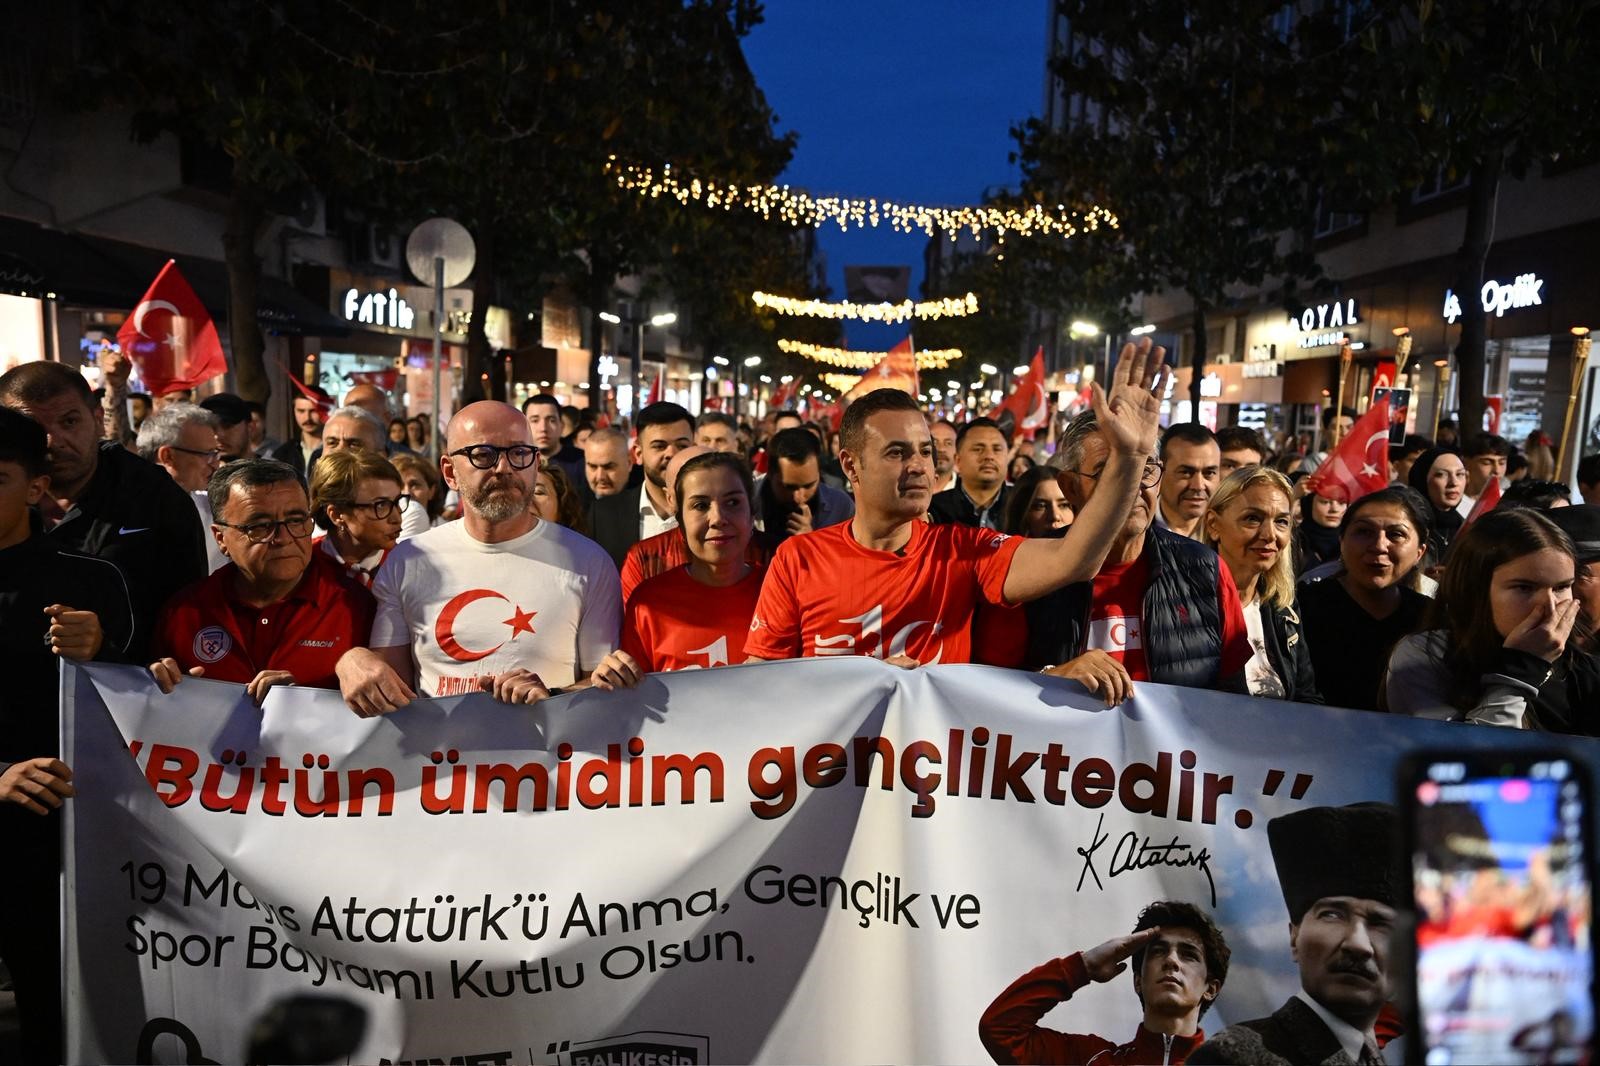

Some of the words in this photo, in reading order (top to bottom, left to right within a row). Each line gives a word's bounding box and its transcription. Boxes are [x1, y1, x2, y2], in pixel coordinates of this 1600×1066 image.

[1481, 272, 1543, 317] Optik
[420, 737, 724, 815] ümidim
[120, 862, 167, 904] 19
[559, 887, 730, 939] Anma,
[744, 864, 921, 929] Gençlik
[930, 893, 981, 929] ve
[124, 914, 235, 970] Spor
[246, 924, 435, 1001] Bayramı
[450, 957, 585, 1000] Kutlu
[599, 930, 755, 980] Olsun.
